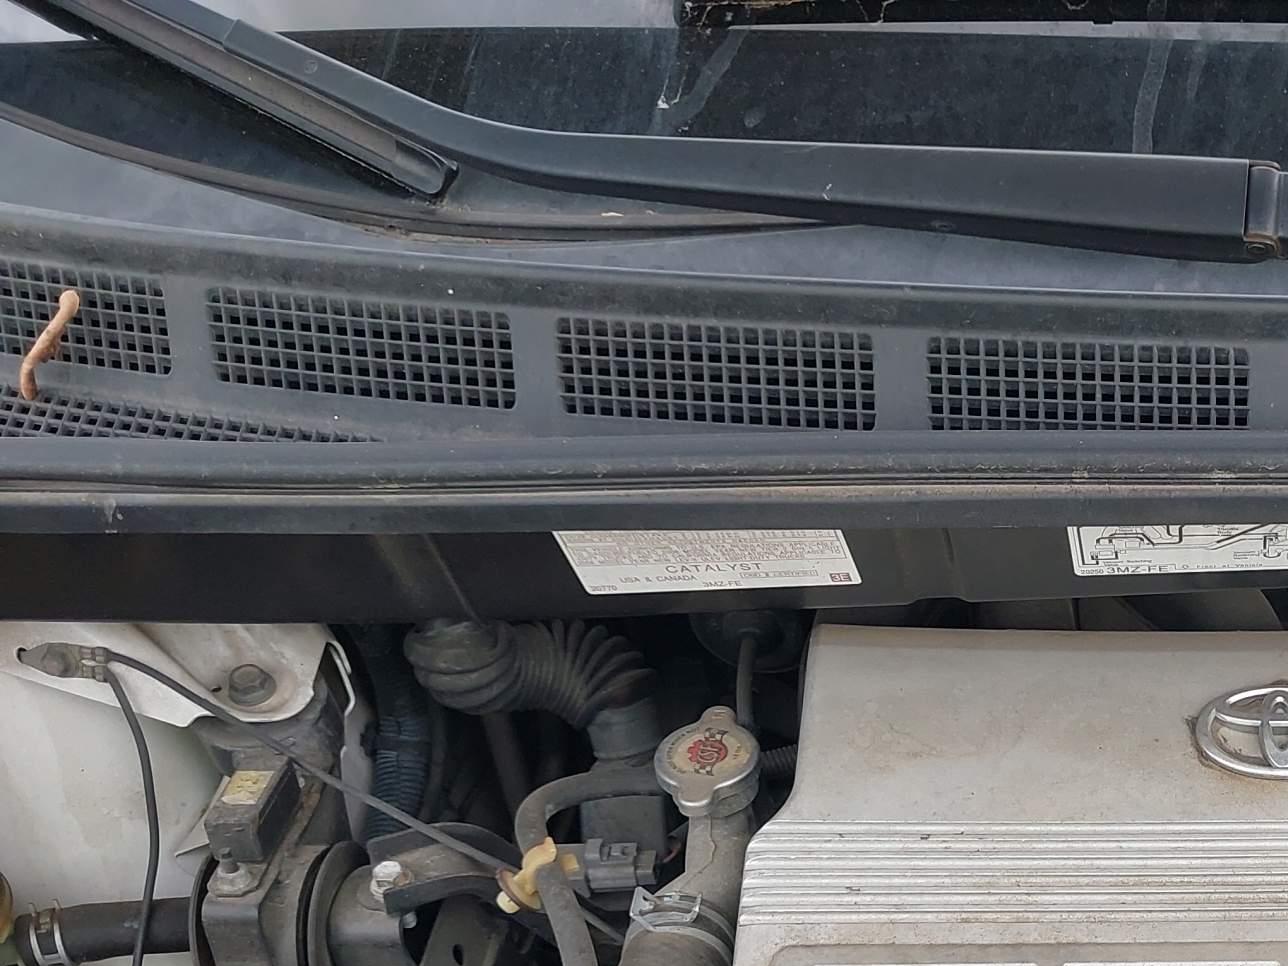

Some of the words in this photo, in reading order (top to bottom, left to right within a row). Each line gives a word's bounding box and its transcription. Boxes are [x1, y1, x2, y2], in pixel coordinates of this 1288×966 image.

[665, 562, 762, 574] CATALYST
[1106, 565, 1169, 574] 3MZ-FE
[656, 574, 698, 582] CANADA
[831, 573, 850, 582] 3E
[703, 580, 743, 588] 3MZ-FE
